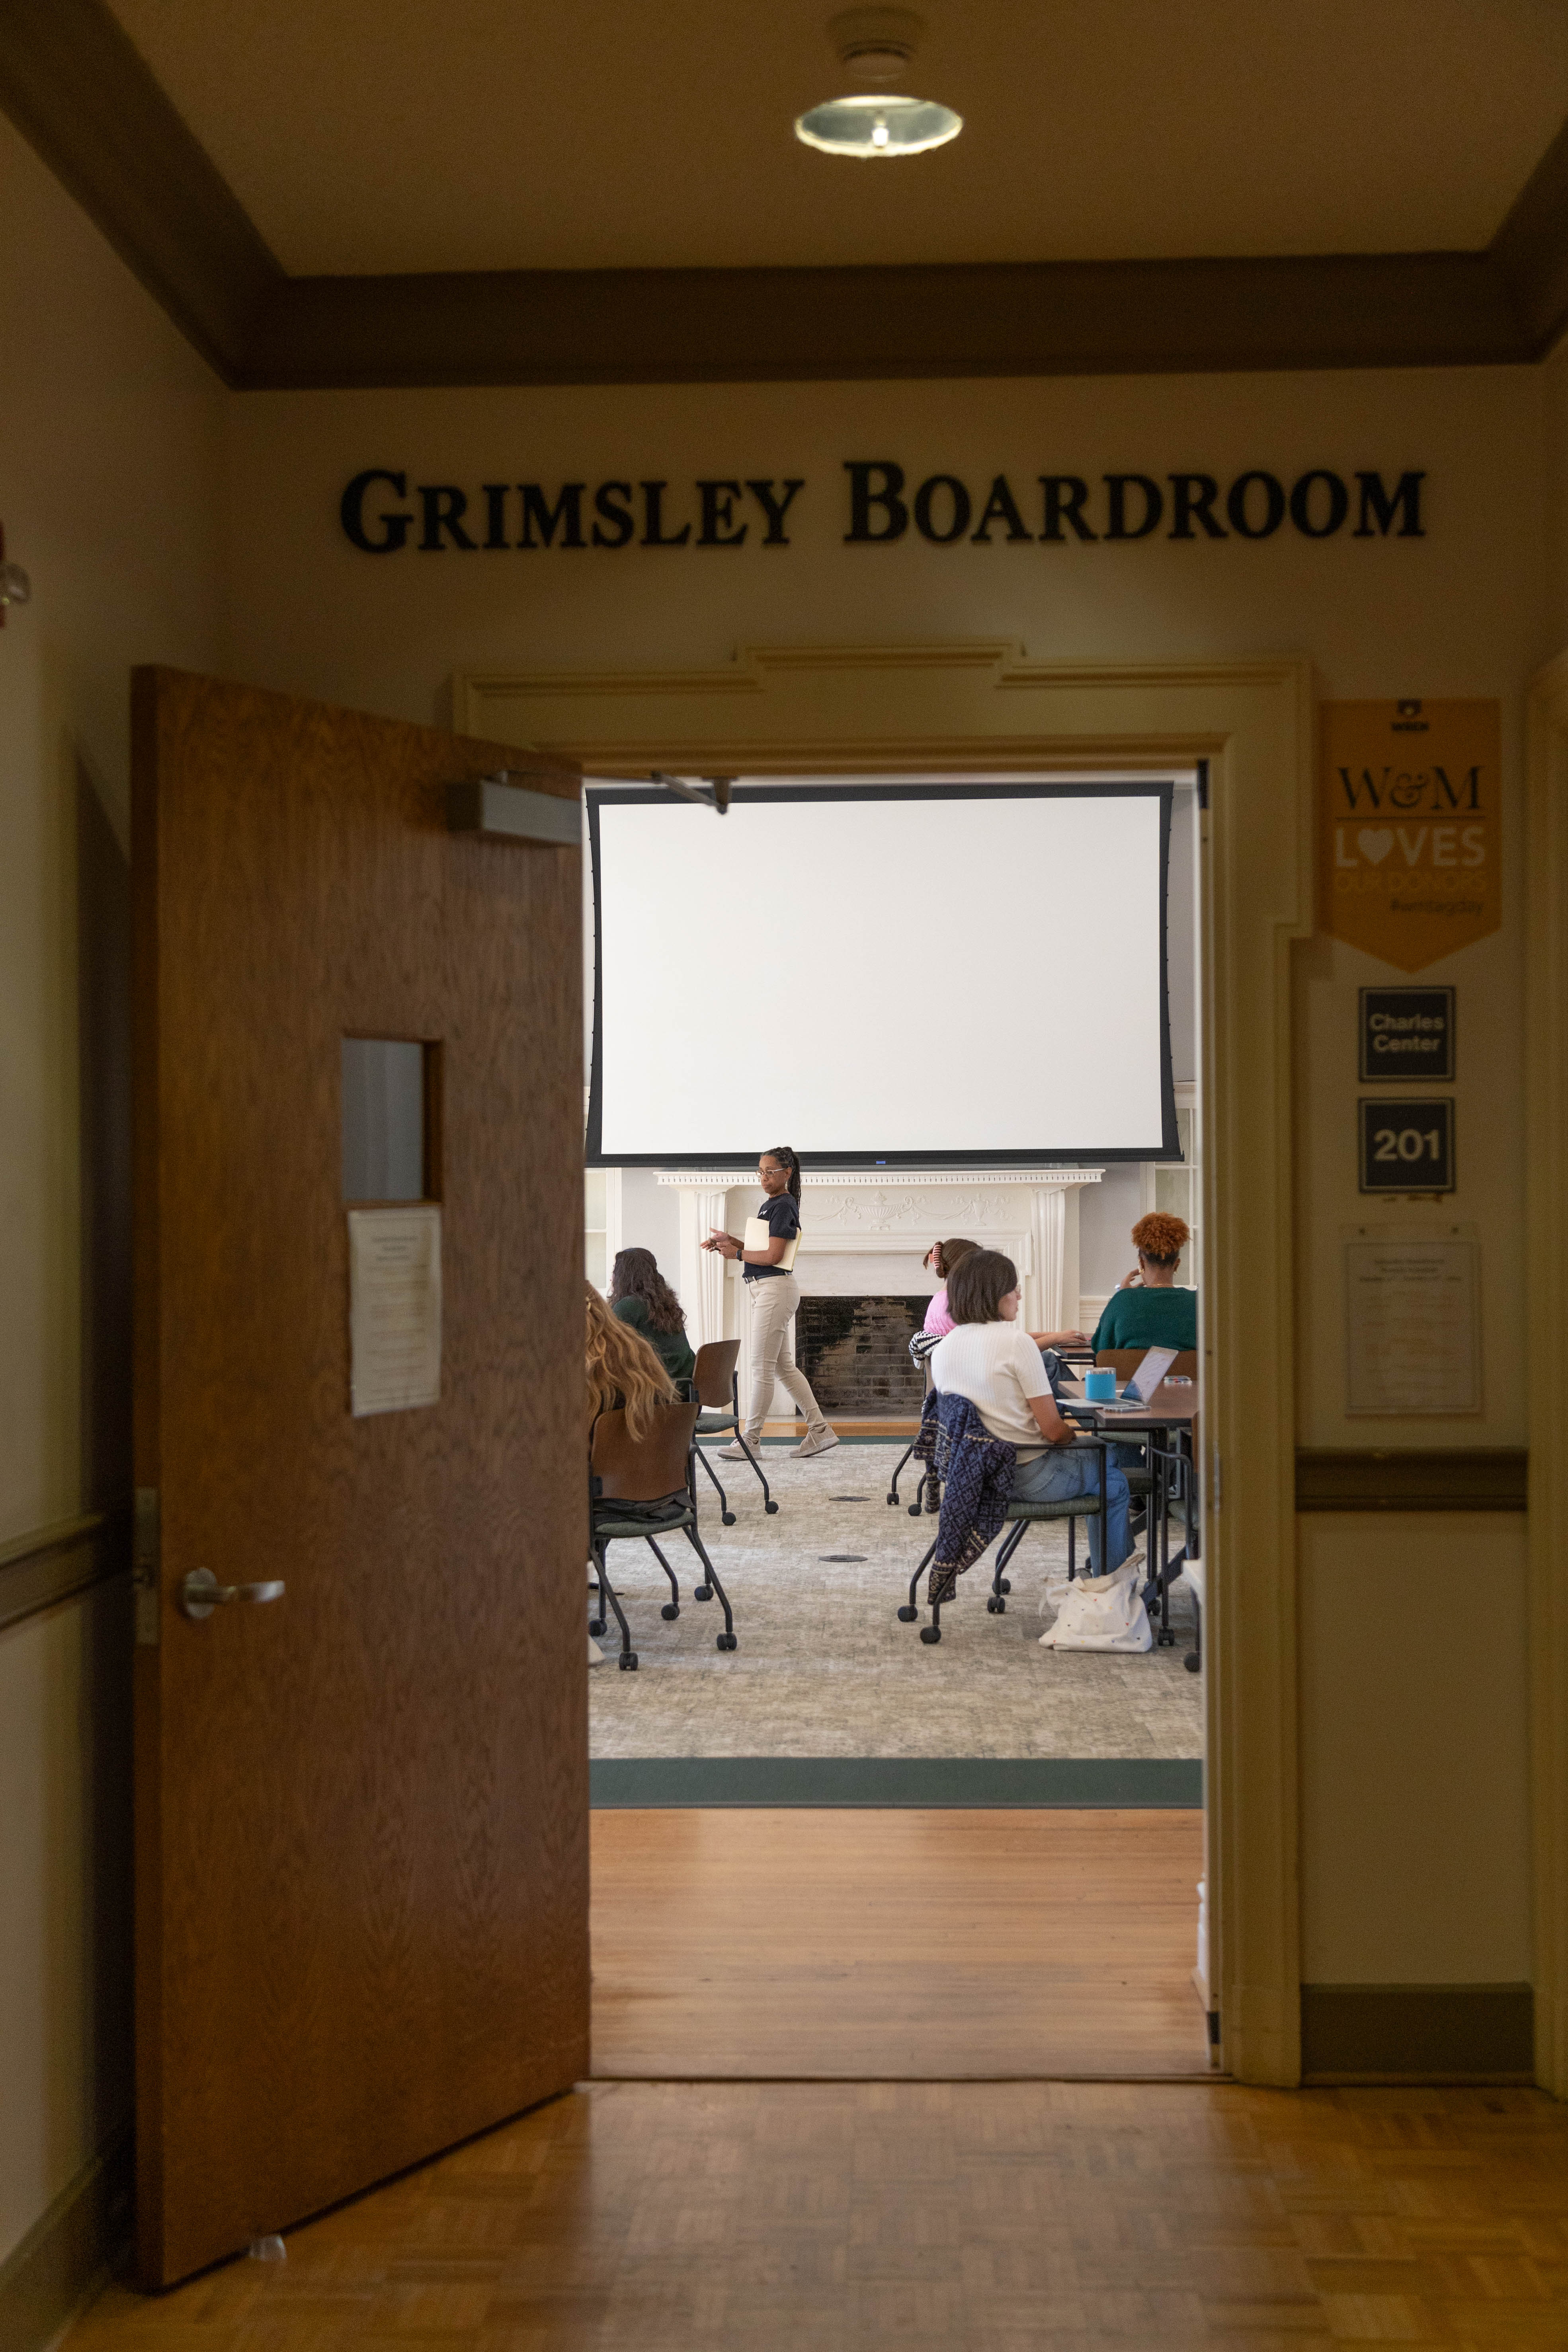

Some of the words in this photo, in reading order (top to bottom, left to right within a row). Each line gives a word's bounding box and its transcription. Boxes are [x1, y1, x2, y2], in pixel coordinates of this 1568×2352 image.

[1336, 765, 1486, 810] W&M
[1369, 1013, 1445, 1031] Charles
[1373, 1034, 1440, 1053] Center
[1374, 1128, 1440, 1161] 201
